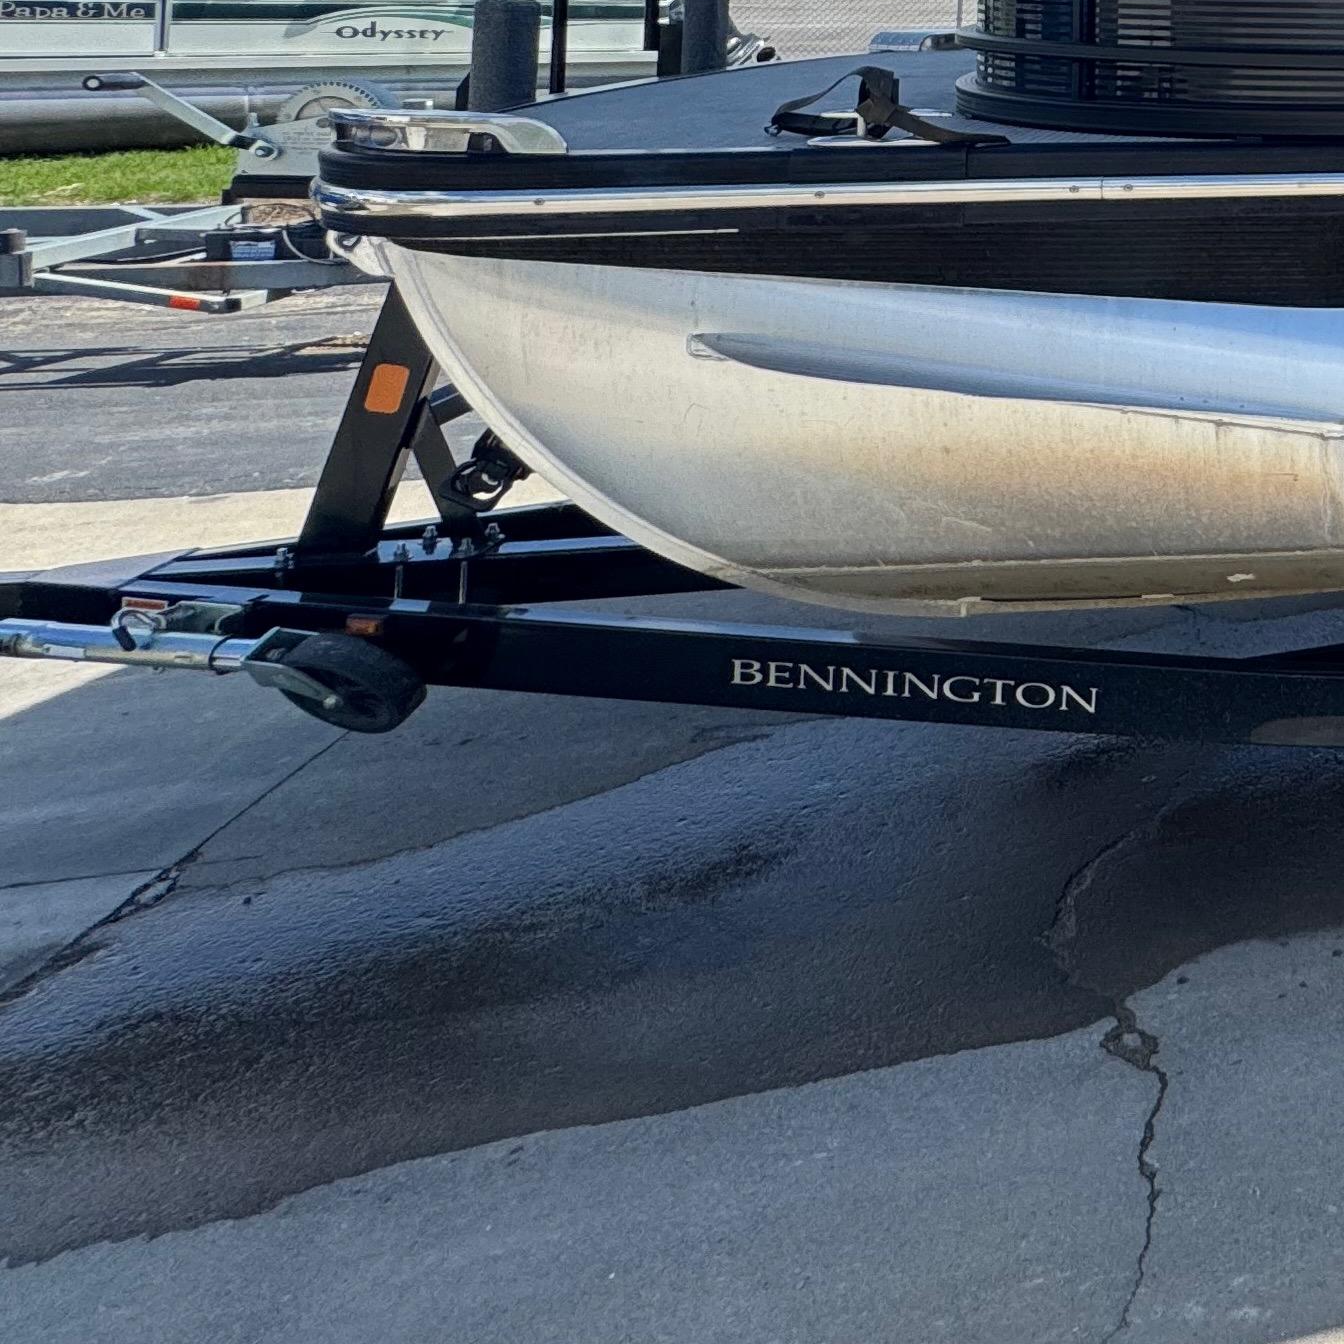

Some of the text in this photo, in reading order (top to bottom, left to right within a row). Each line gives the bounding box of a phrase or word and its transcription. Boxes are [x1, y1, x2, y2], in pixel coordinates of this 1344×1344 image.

[0, 1, 146, 19] Papa & Me
[335, 21, 445, 42] Odyssey
[730, 658, 1099, 714] BENNINGTON
